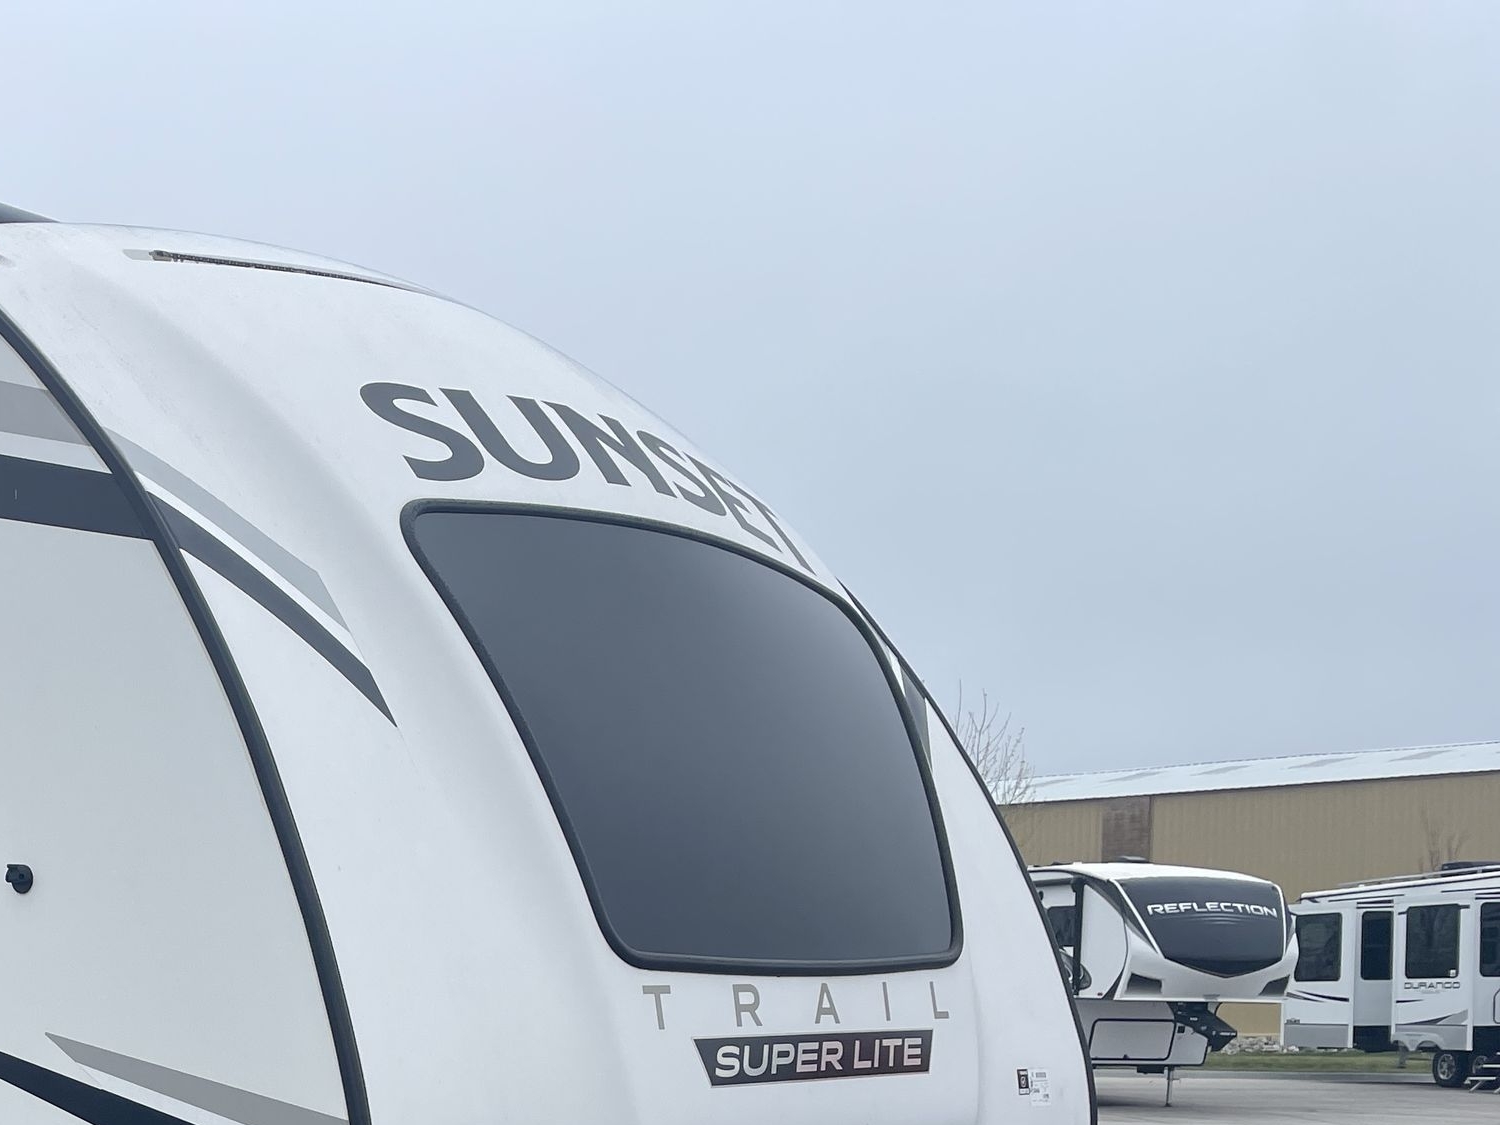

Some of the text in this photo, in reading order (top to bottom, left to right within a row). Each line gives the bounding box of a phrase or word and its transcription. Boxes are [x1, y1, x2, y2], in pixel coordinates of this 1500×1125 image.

[359, 382, 817, 576] SUNSET
[1146, 901, 1278, 918] REFLECTION
[642, 981, 949, 1030] TRAIL
[715, 1037, 922, 1077] SUPER LITE
